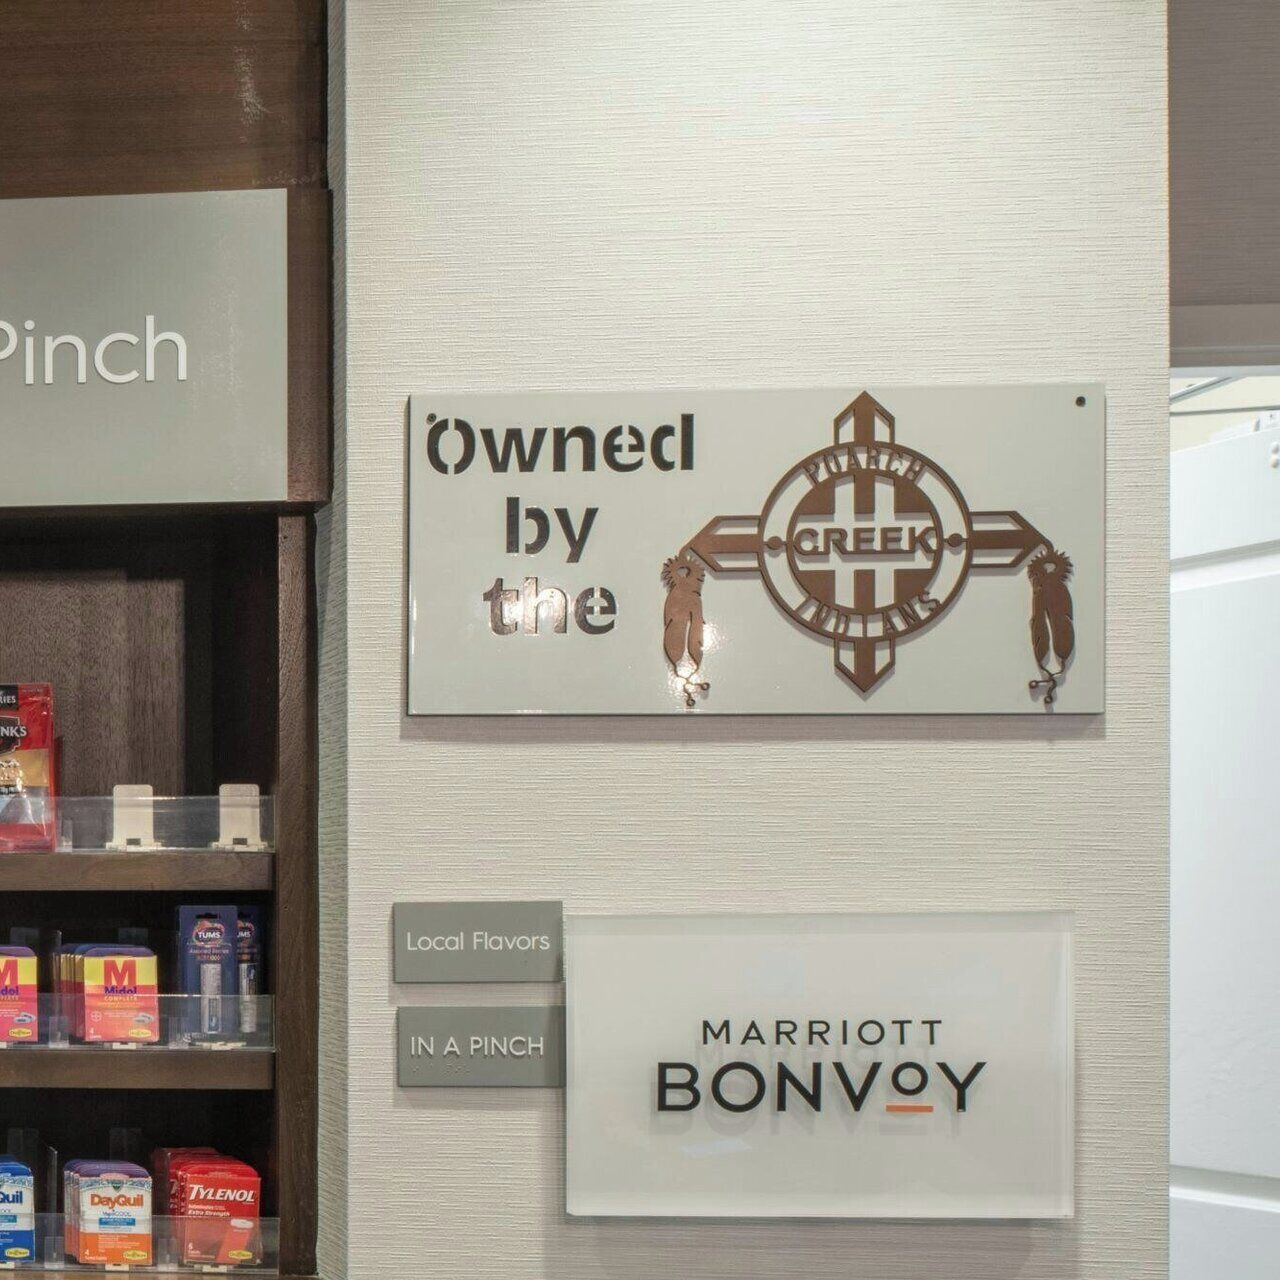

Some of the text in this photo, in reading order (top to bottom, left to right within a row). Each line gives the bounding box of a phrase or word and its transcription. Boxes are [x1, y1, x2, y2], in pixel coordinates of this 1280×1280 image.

[426, 413, 695, 475] Owned
[505, 496, 600, 564] by
[793, 526, 938, 556] CREEK
[482, 576, 618, 636] the
[793, 589, 942, 637] INDIANS
[197, 931, 221, 939] TUMS
[406, 930, 550, 951] Local Flavors
[103, 959, 137, 986] M
[104, 985, 138, 996] Midol
[701, 1018, 943, 1046] MARRIOTT
[409, 1034, 545, 1058] IN A PINCH
[657, 1061, 987, 1113] BONVOY
[90, 1193, 144, 1210] DayQuil
[188, 1183, 257, 1203] TYLENOL
